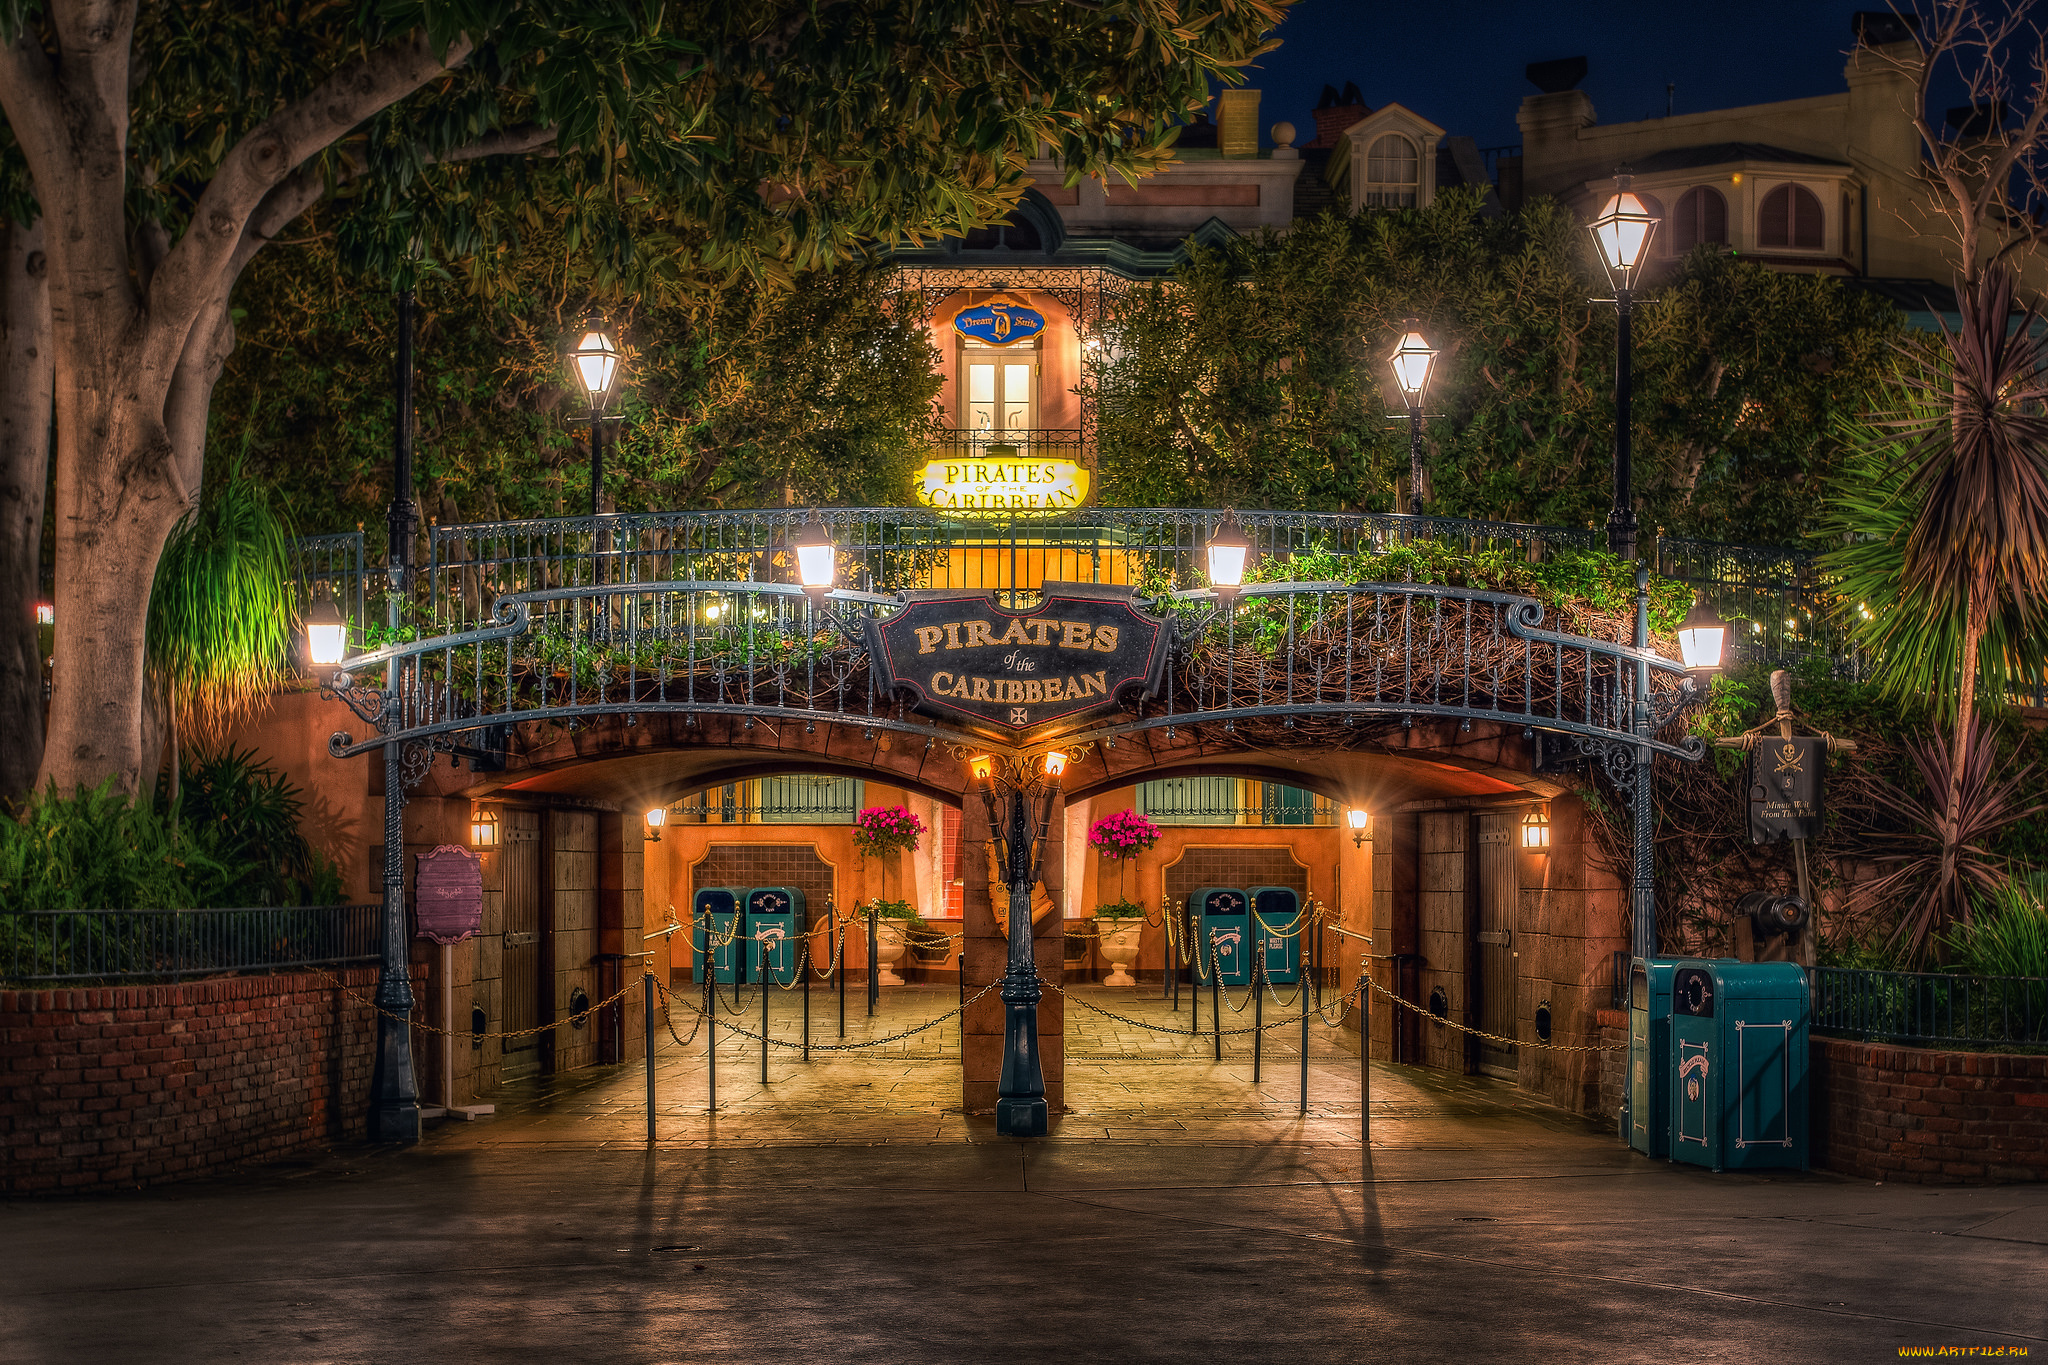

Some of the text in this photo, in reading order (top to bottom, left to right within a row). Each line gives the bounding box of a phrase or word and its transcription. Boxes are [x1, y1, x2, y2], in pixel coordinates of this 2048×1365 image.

[962, 316, 1038, 329] Dream Suite
[943, 464, 1056, 484] PIRATES
[929, 485, 1077, 508] CARIBBEAN
[975, 485, 1027, 493] OF THE
[914, 618, 1119, 655] PIRATES
[1003, 650, 1035, 672] of the
[931, 670, 1107, 703] CARIBBEAN
[1784, 778, 1791, 788] 5
[1760, 809, 1817, 818] From This Point
